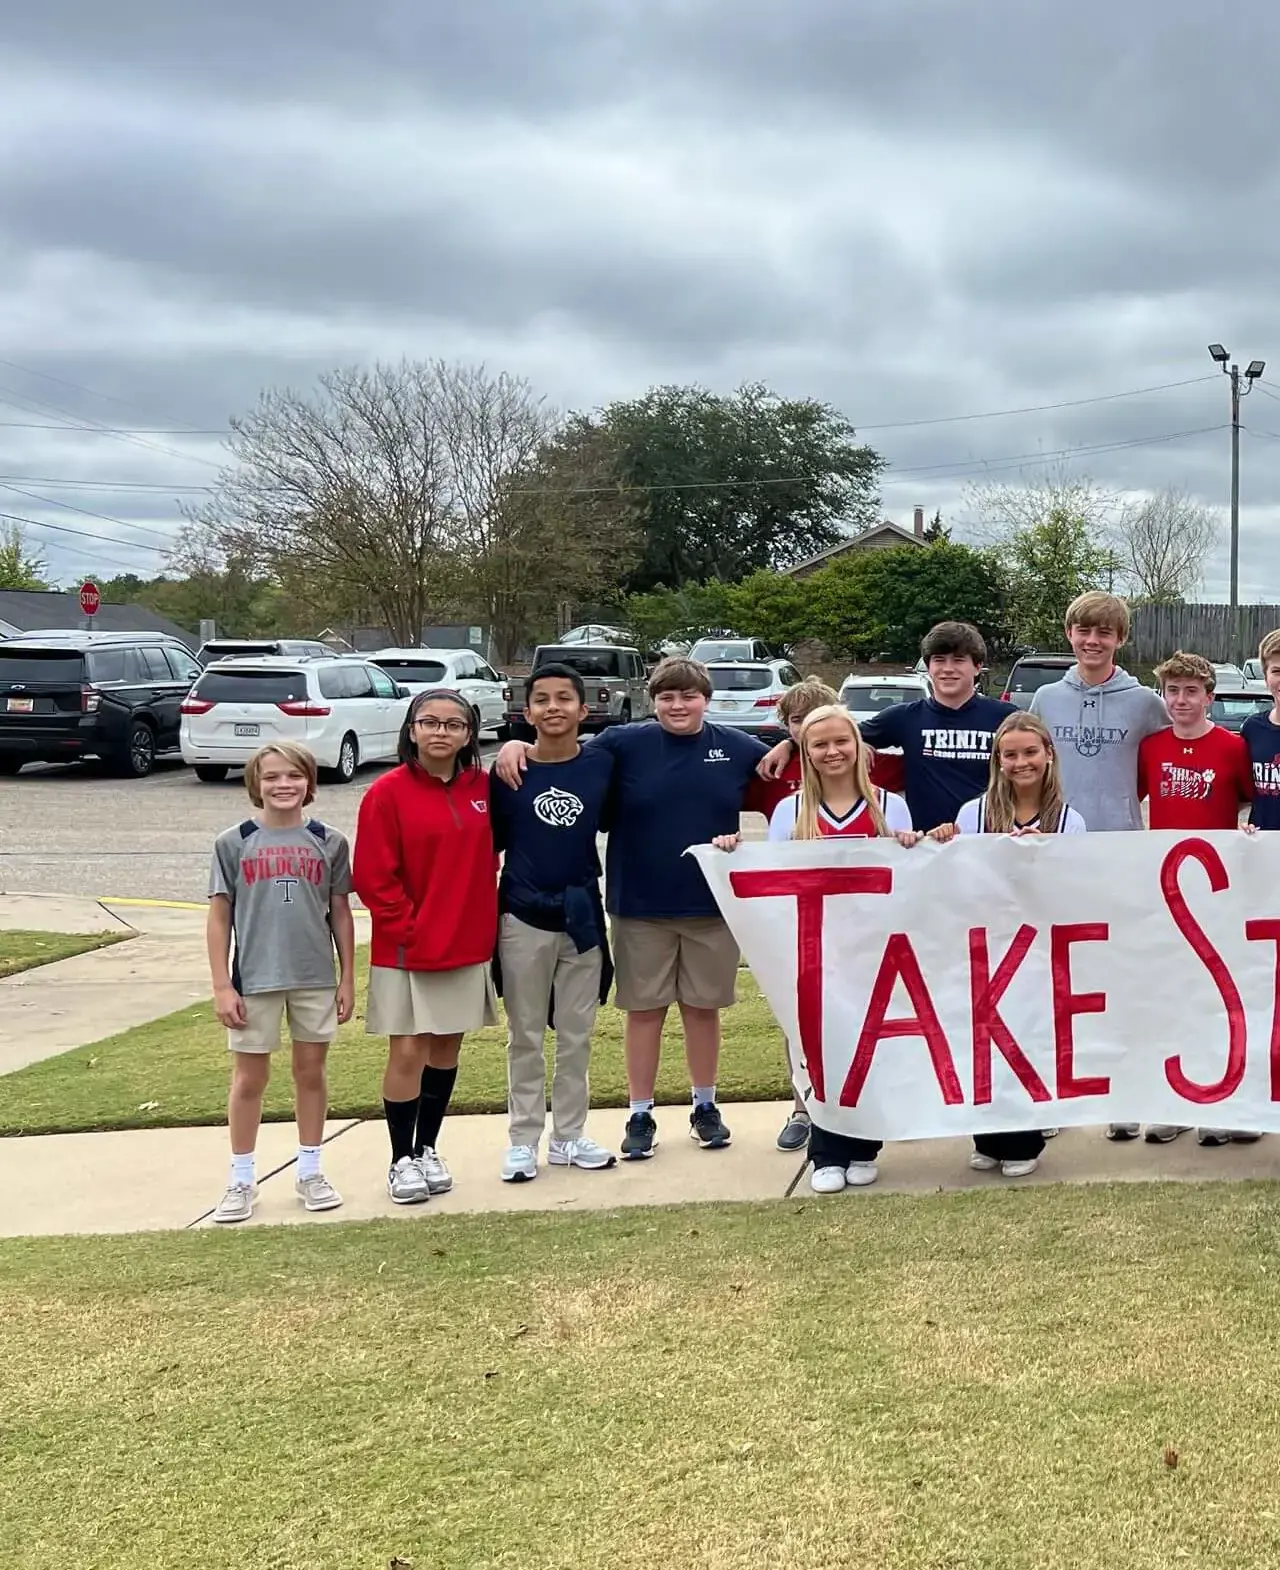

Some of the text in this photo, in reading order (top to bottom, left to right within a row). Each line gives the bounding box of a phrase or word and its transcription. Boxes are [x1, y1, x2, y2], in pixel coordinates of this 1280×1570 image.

[82, 592, 99, 605] STOP
[933, 750, 991, 760] CROSS COUNTRY
[257, 846, 312, 857] TRINITY
[241, 857, 325, 887] WILDCATS
[274, 879, 299, 904] T
[729, 866, 1110, 1108] TAKE
